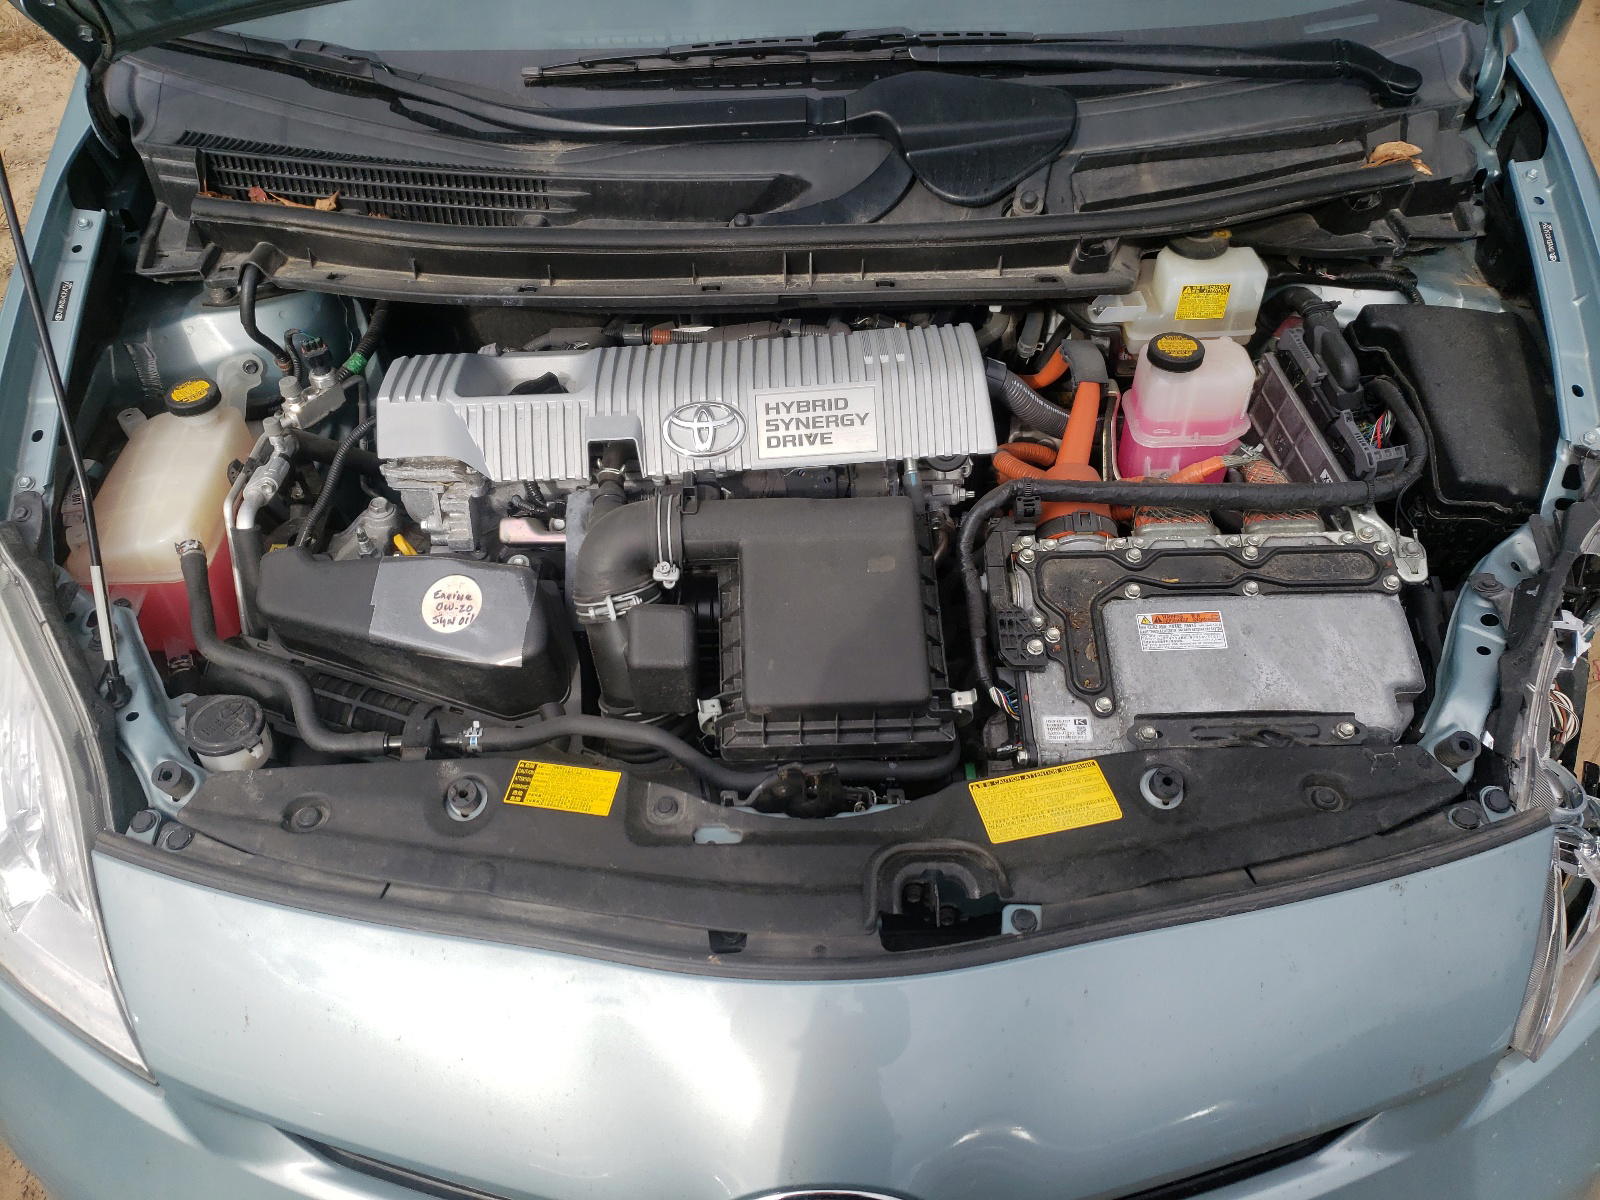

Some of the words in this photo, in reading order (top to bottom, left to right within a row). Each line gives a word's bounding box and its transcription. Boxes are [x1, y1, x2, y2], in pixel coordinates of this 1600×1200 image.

[764, 397, 849, 415] HYBRID
[765, 412, 870, 433] SYNERGY
[766, 432, 833, 449] DRIVE
